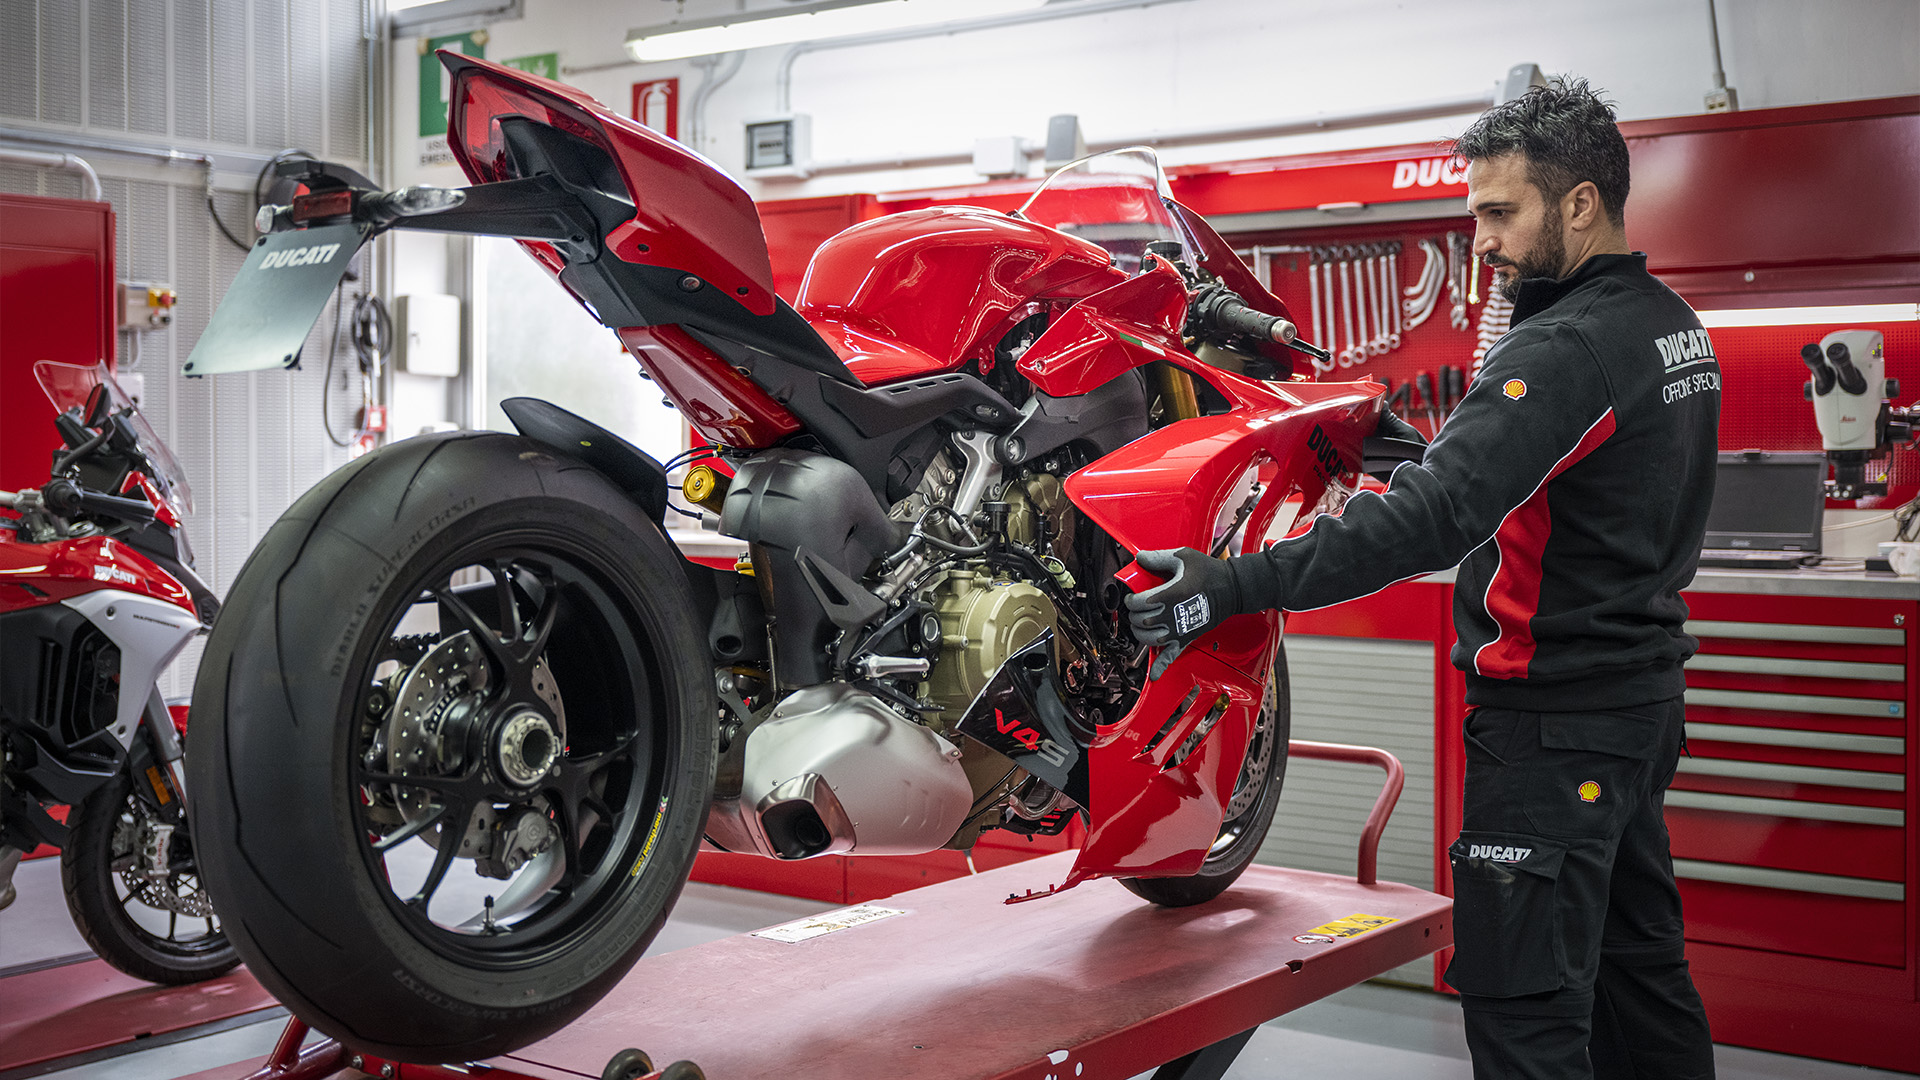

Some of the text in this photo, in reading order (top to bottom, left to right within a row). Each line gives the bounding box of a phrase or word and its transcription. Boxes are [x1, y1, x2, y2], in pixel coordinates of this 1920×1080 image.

[1392, 158, 1468, 190] DUC
[258, 242, 341, 270] DUCATI
[1654, 328, 1714, 368] DUCATI
[93, 564, 136, 585] DUCATI
[643, 811, 662, 857] marchesini
[1469, 844, 1532, 861] DUCATI
